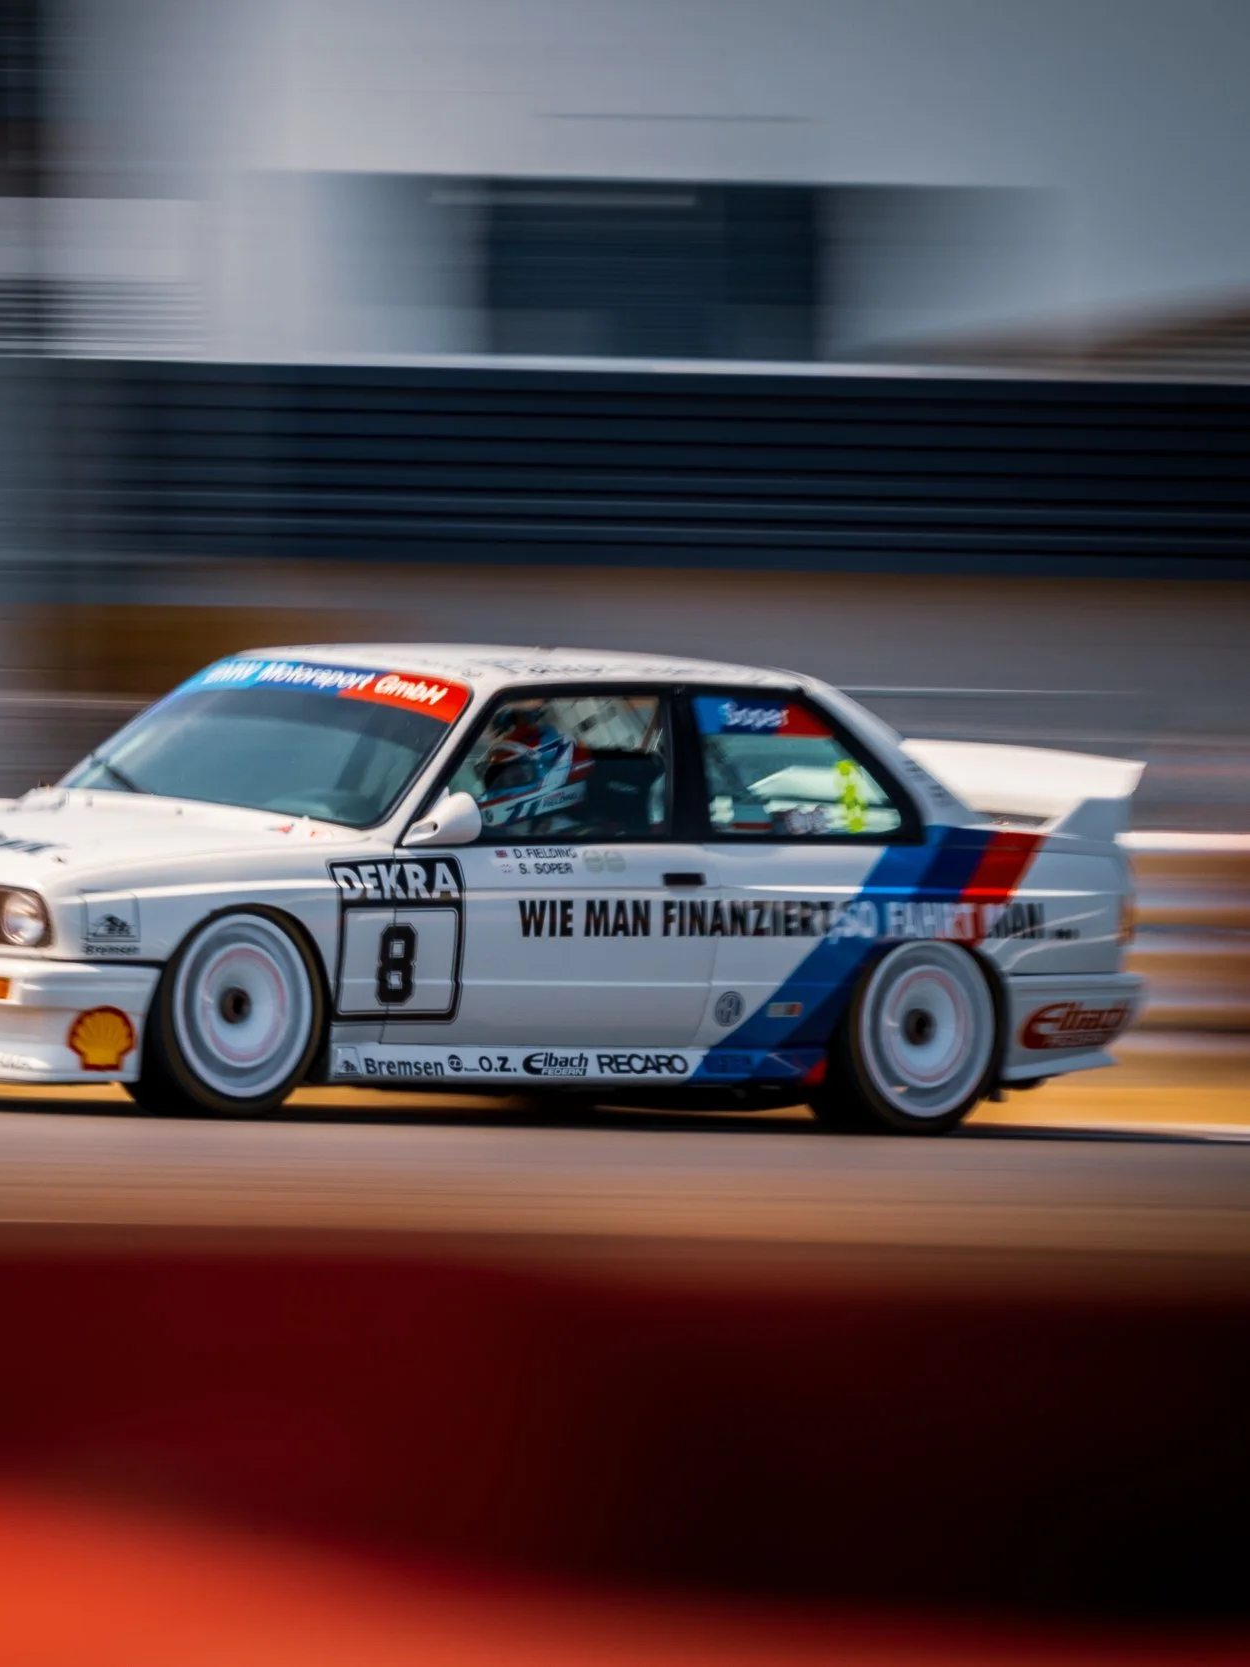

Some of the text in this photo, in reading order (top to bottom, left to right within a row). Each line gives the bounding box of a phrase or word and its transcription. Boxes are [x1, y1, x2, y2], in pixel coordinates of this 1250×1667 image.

[255, 660, 376, 691] Motorsport
[374, 674, 449, 705] GmbH
[332, 862, 460, 899] DEKRA
[534, 863, 574, 874] SOPER
[519, 900, 573, 937] WIE
[584, 900, 651, 937] MAN
[376, 923, 417, 1005] 8
[364, 1057, 445, 1076] Bremsen
[597, 1054, 688, 1074] RECARO
